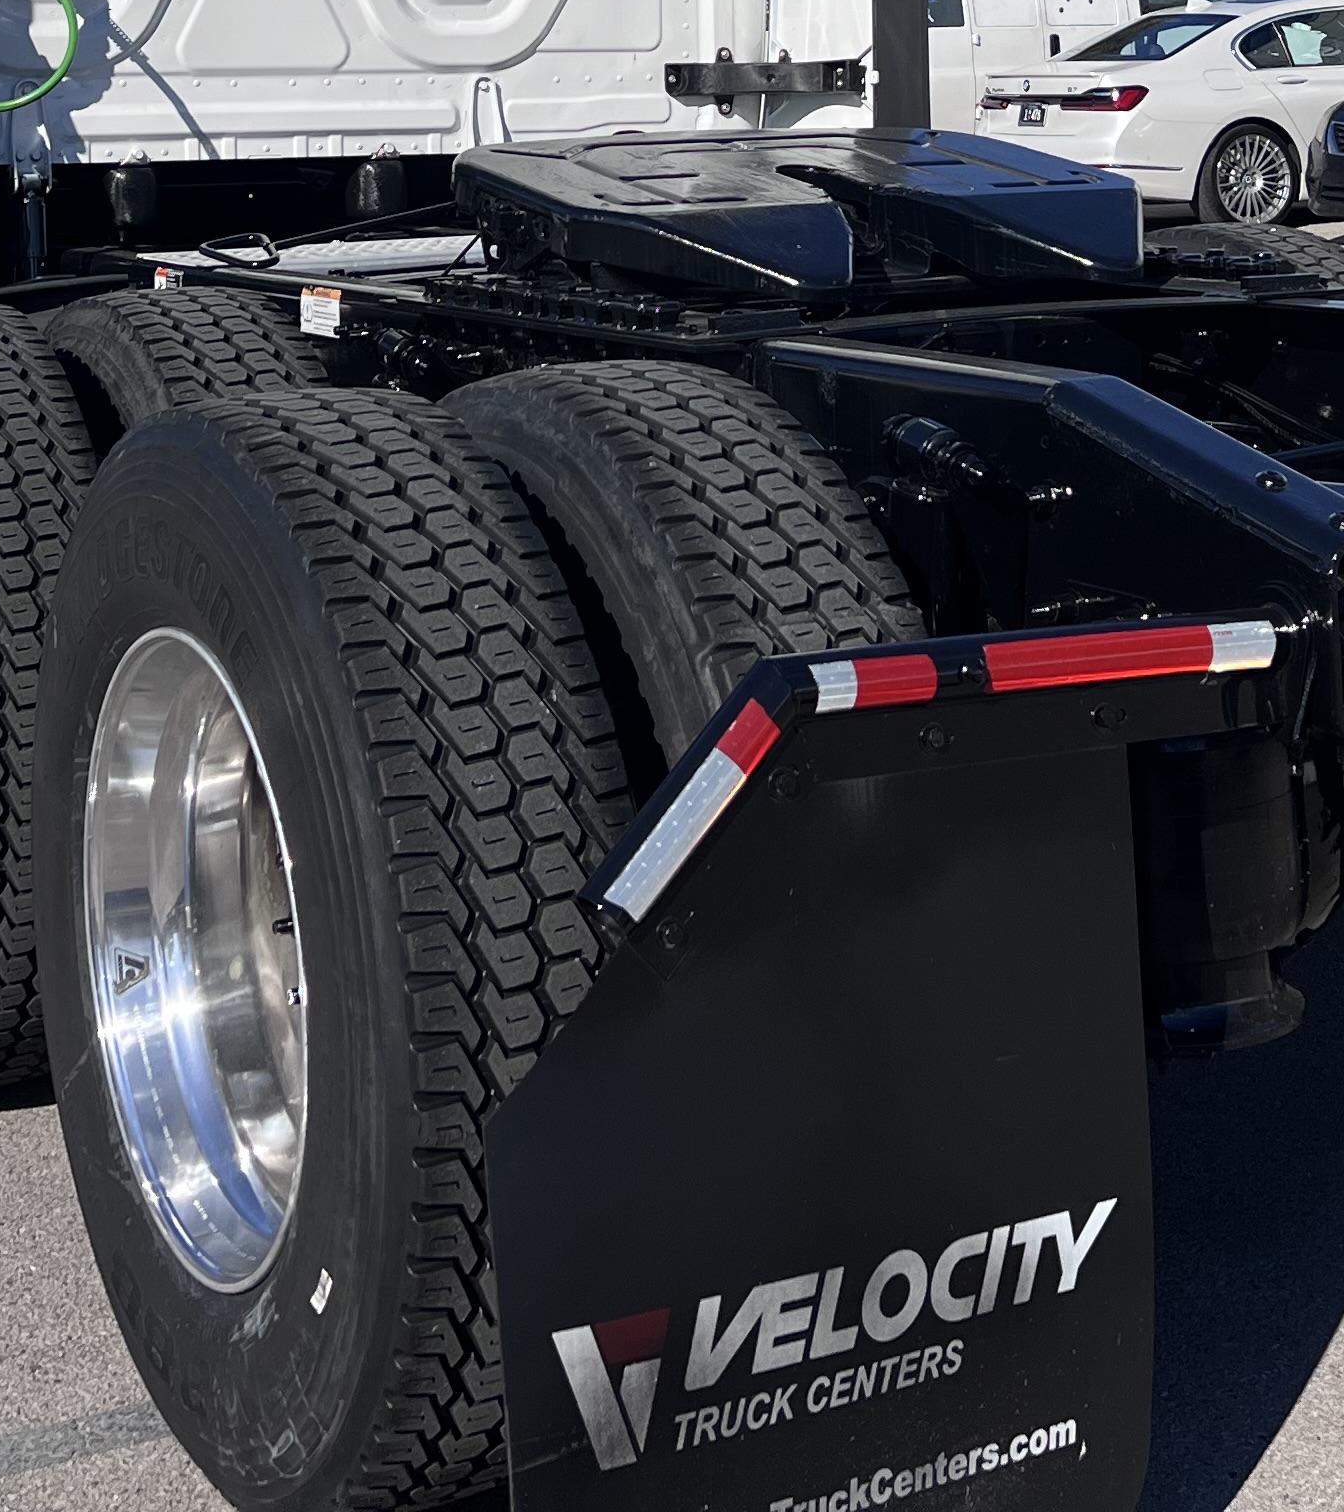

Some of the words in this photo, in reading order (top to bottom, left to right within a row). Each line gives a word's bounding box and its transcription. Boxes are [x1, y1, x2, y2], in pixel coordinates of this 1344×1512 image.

[683, 1197, 1118, 1392] VELOCITY
[673, 1382, 798, 1452] TRUCK
[806, 1338, 964, 1411] CENTERS
